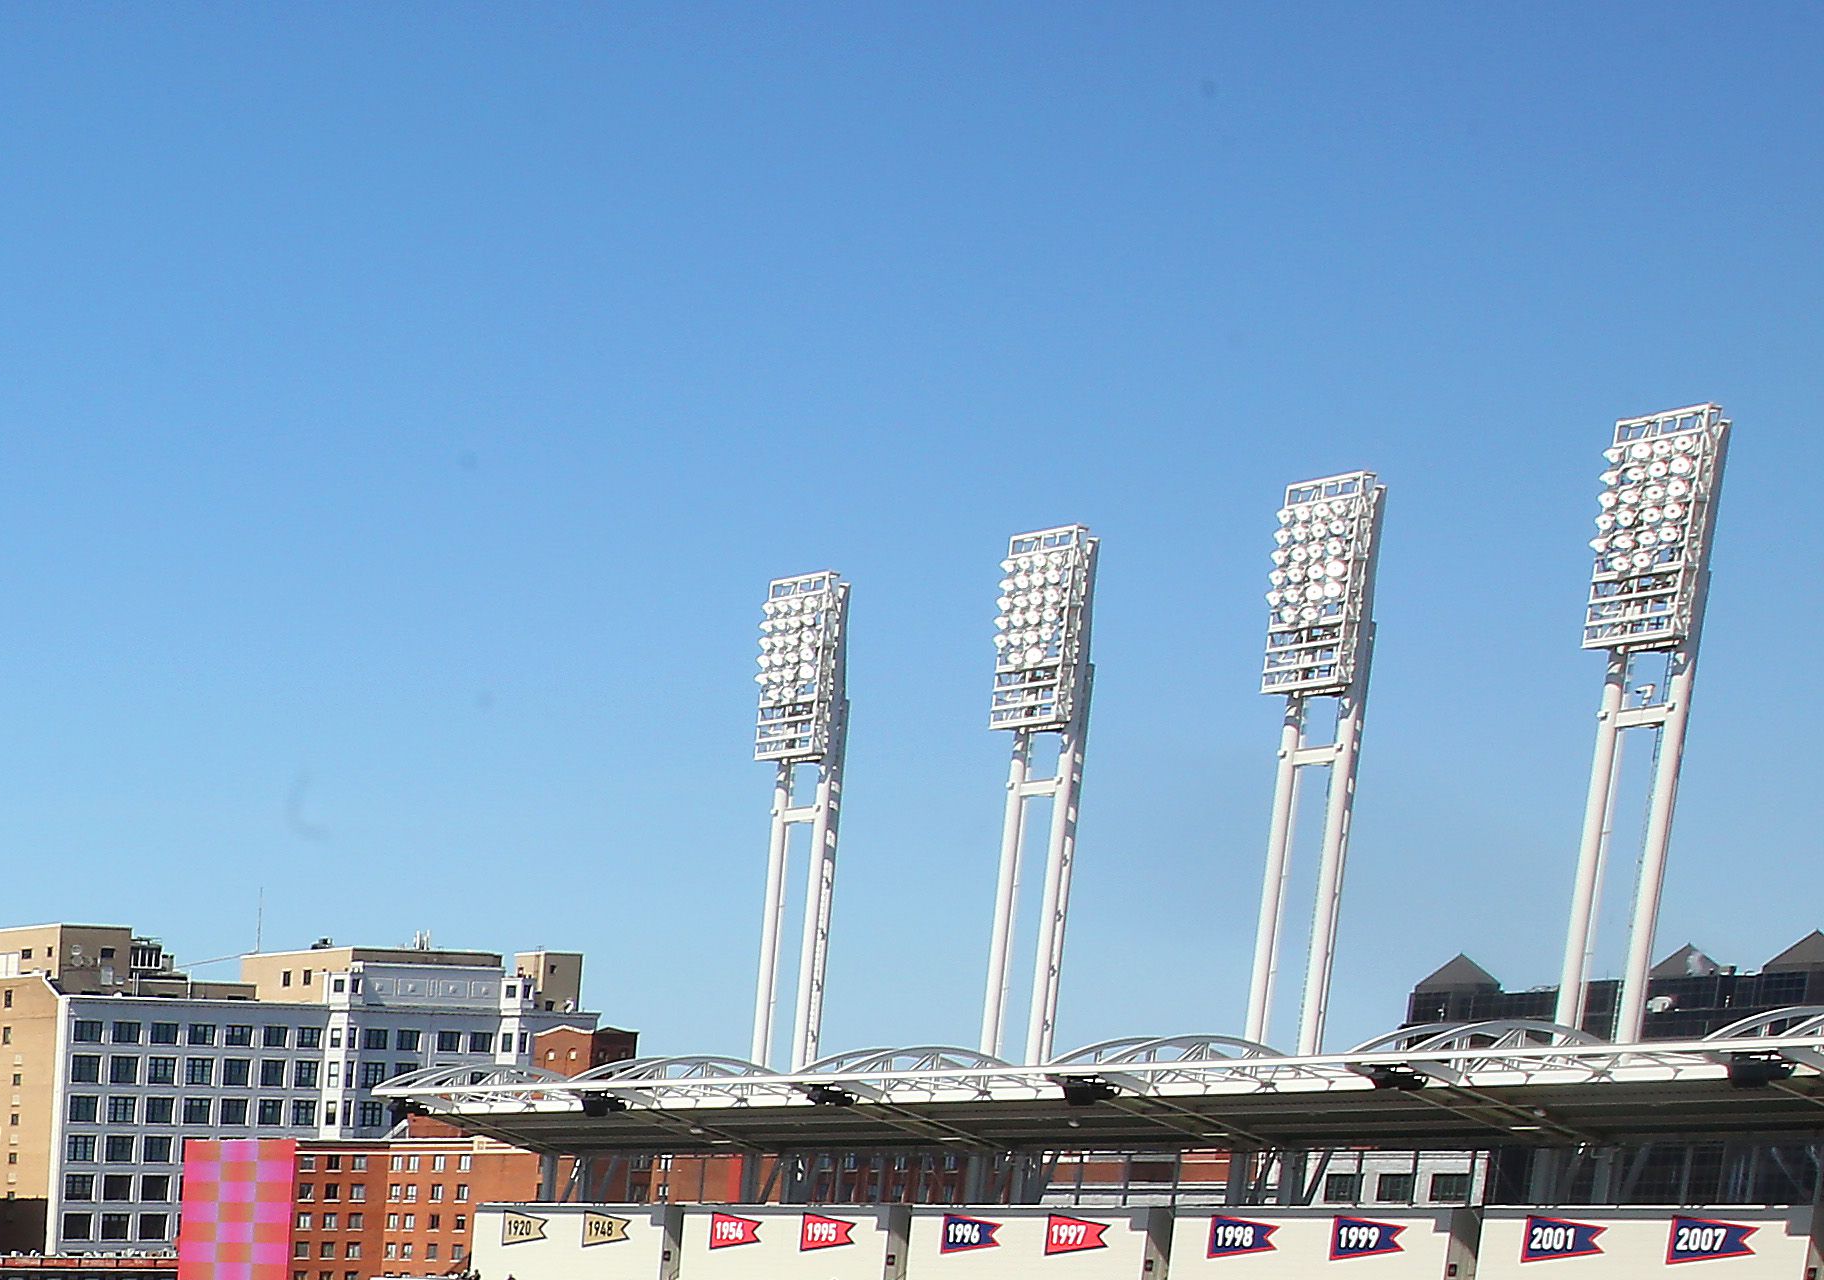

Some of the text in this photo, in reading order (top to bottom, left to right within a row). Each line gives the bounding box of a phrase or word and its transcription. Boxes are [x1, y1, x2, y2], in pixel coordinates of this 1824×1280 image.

[507, 1219, 532, 1239] 1920
[587, 1220, 615, 1240] 1948
[715, 1221, 745, 1242] 1954
[806, 1222, 837, 1243] 1995
[947, 1223, 980, 1245] 1996
[1051, 1224, 1087, 1246] 1997
[1216, 1225, 1254, 1248] 1998
[1338, 1226, 1379, 1249] 1999
[1529, 1226, 1575, 1250] 2001
[1675, 1227, 1727, 1252] 2007
